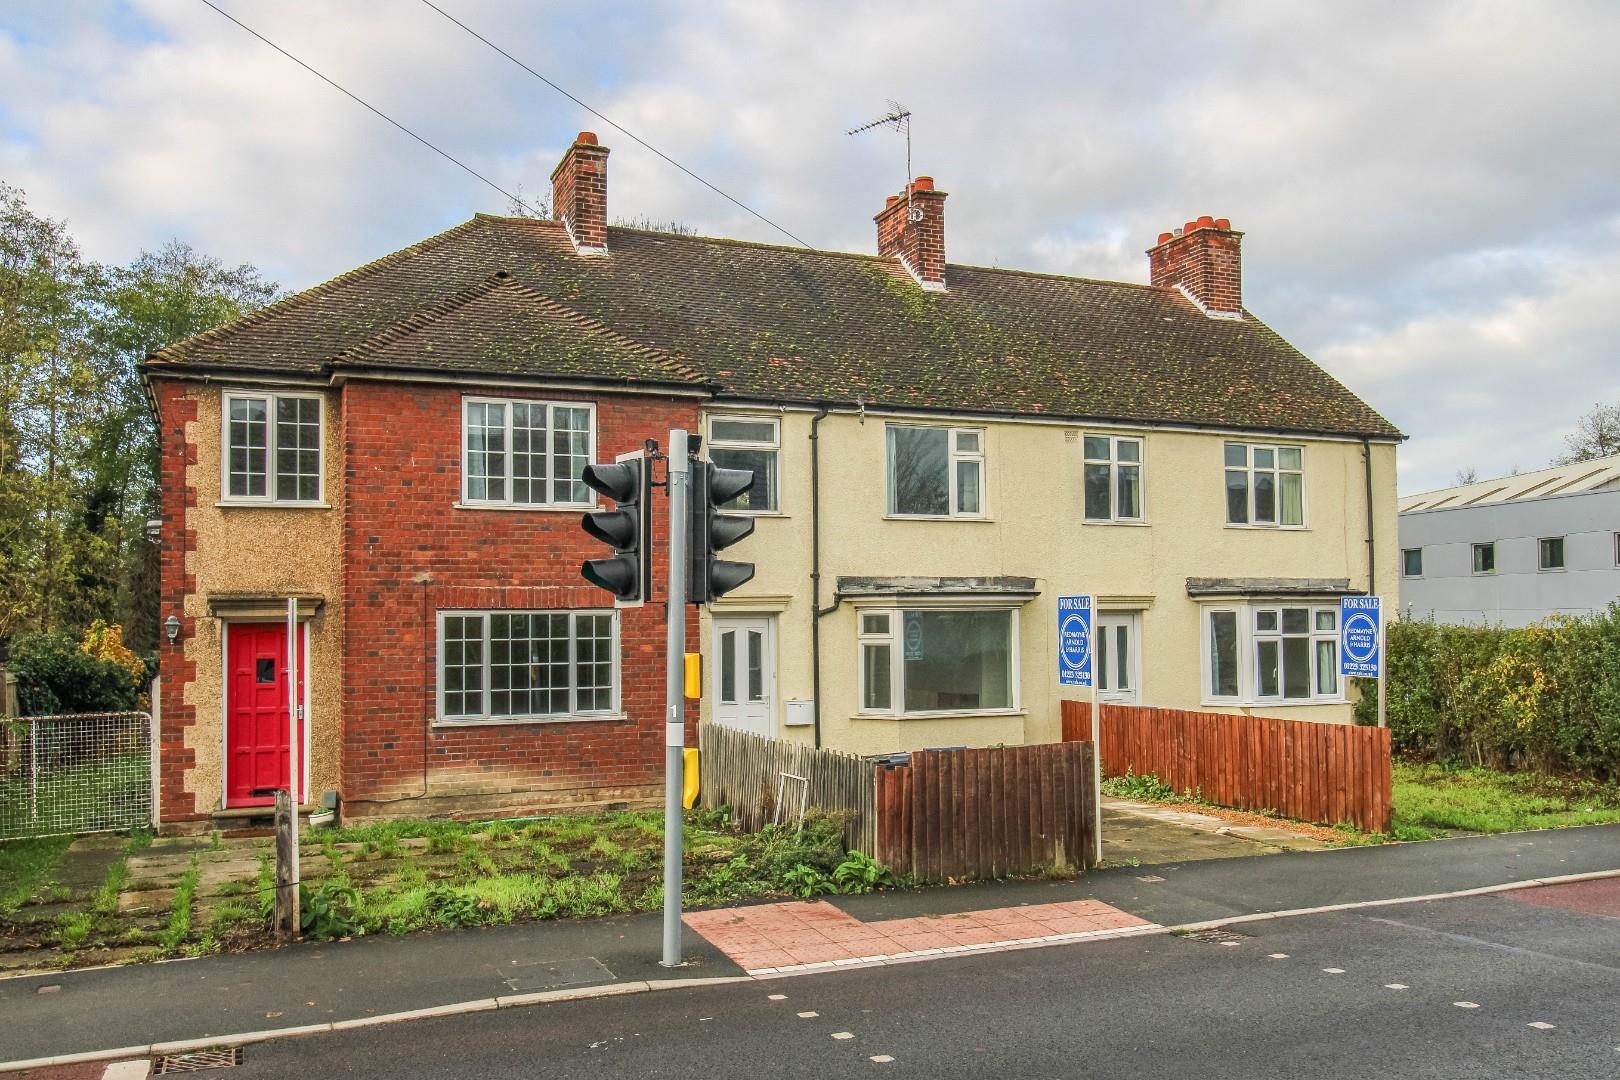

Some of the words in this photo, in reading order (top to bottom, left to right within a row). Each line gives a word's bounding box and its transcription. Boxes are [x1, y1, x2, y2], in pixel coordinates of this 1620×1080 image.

[1060, 598, 1073, 609] FOR
[1074, 598, 1089, 609] SALE
[1344, 599, 1358, 608] FOR
[1360, 599, 1378, 609] SALE
[669, 704, 677, 718] 1
